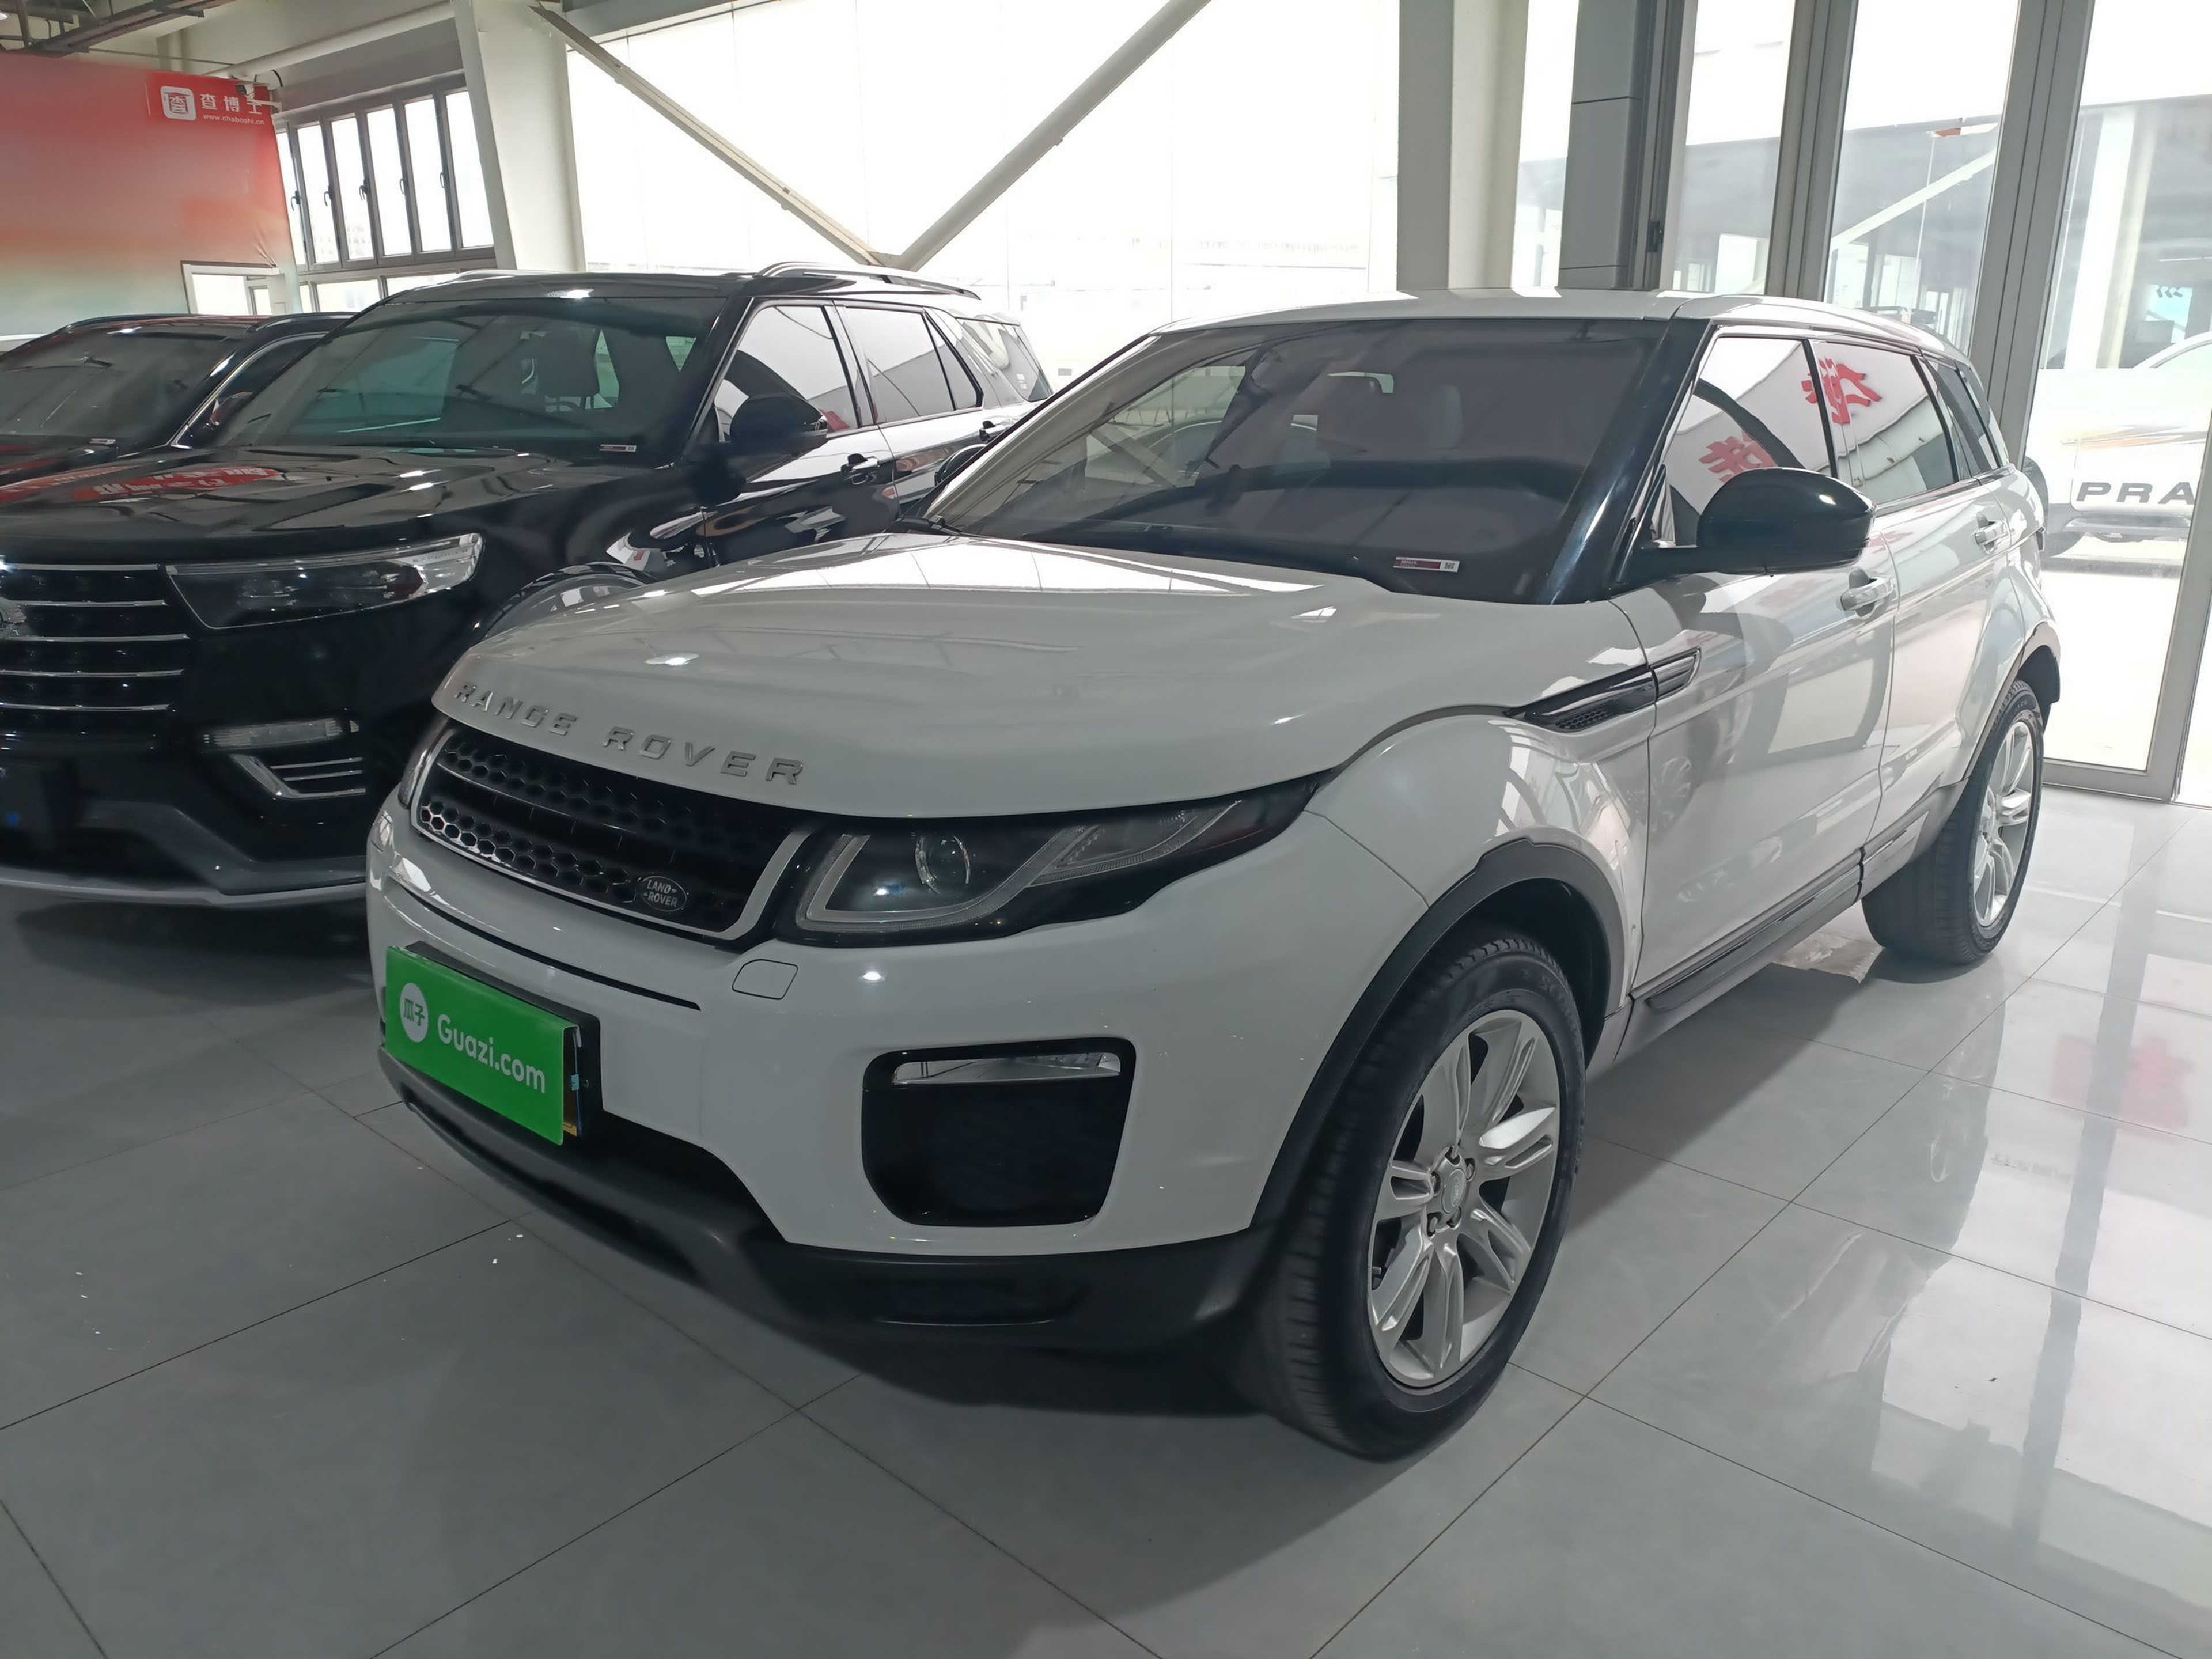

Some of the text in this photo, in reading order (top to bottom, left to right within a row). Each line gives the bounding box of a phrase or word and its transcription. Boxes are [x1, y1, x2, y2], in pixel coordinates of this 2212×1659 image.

[202, 113, 266, 126] www.chaboshi.cn
[454, 681, 804, 786] RANGE ROVER
[403, 998, 426, 1026] 瓜子
[437, 1013, 546, 1094] Guazi.com
